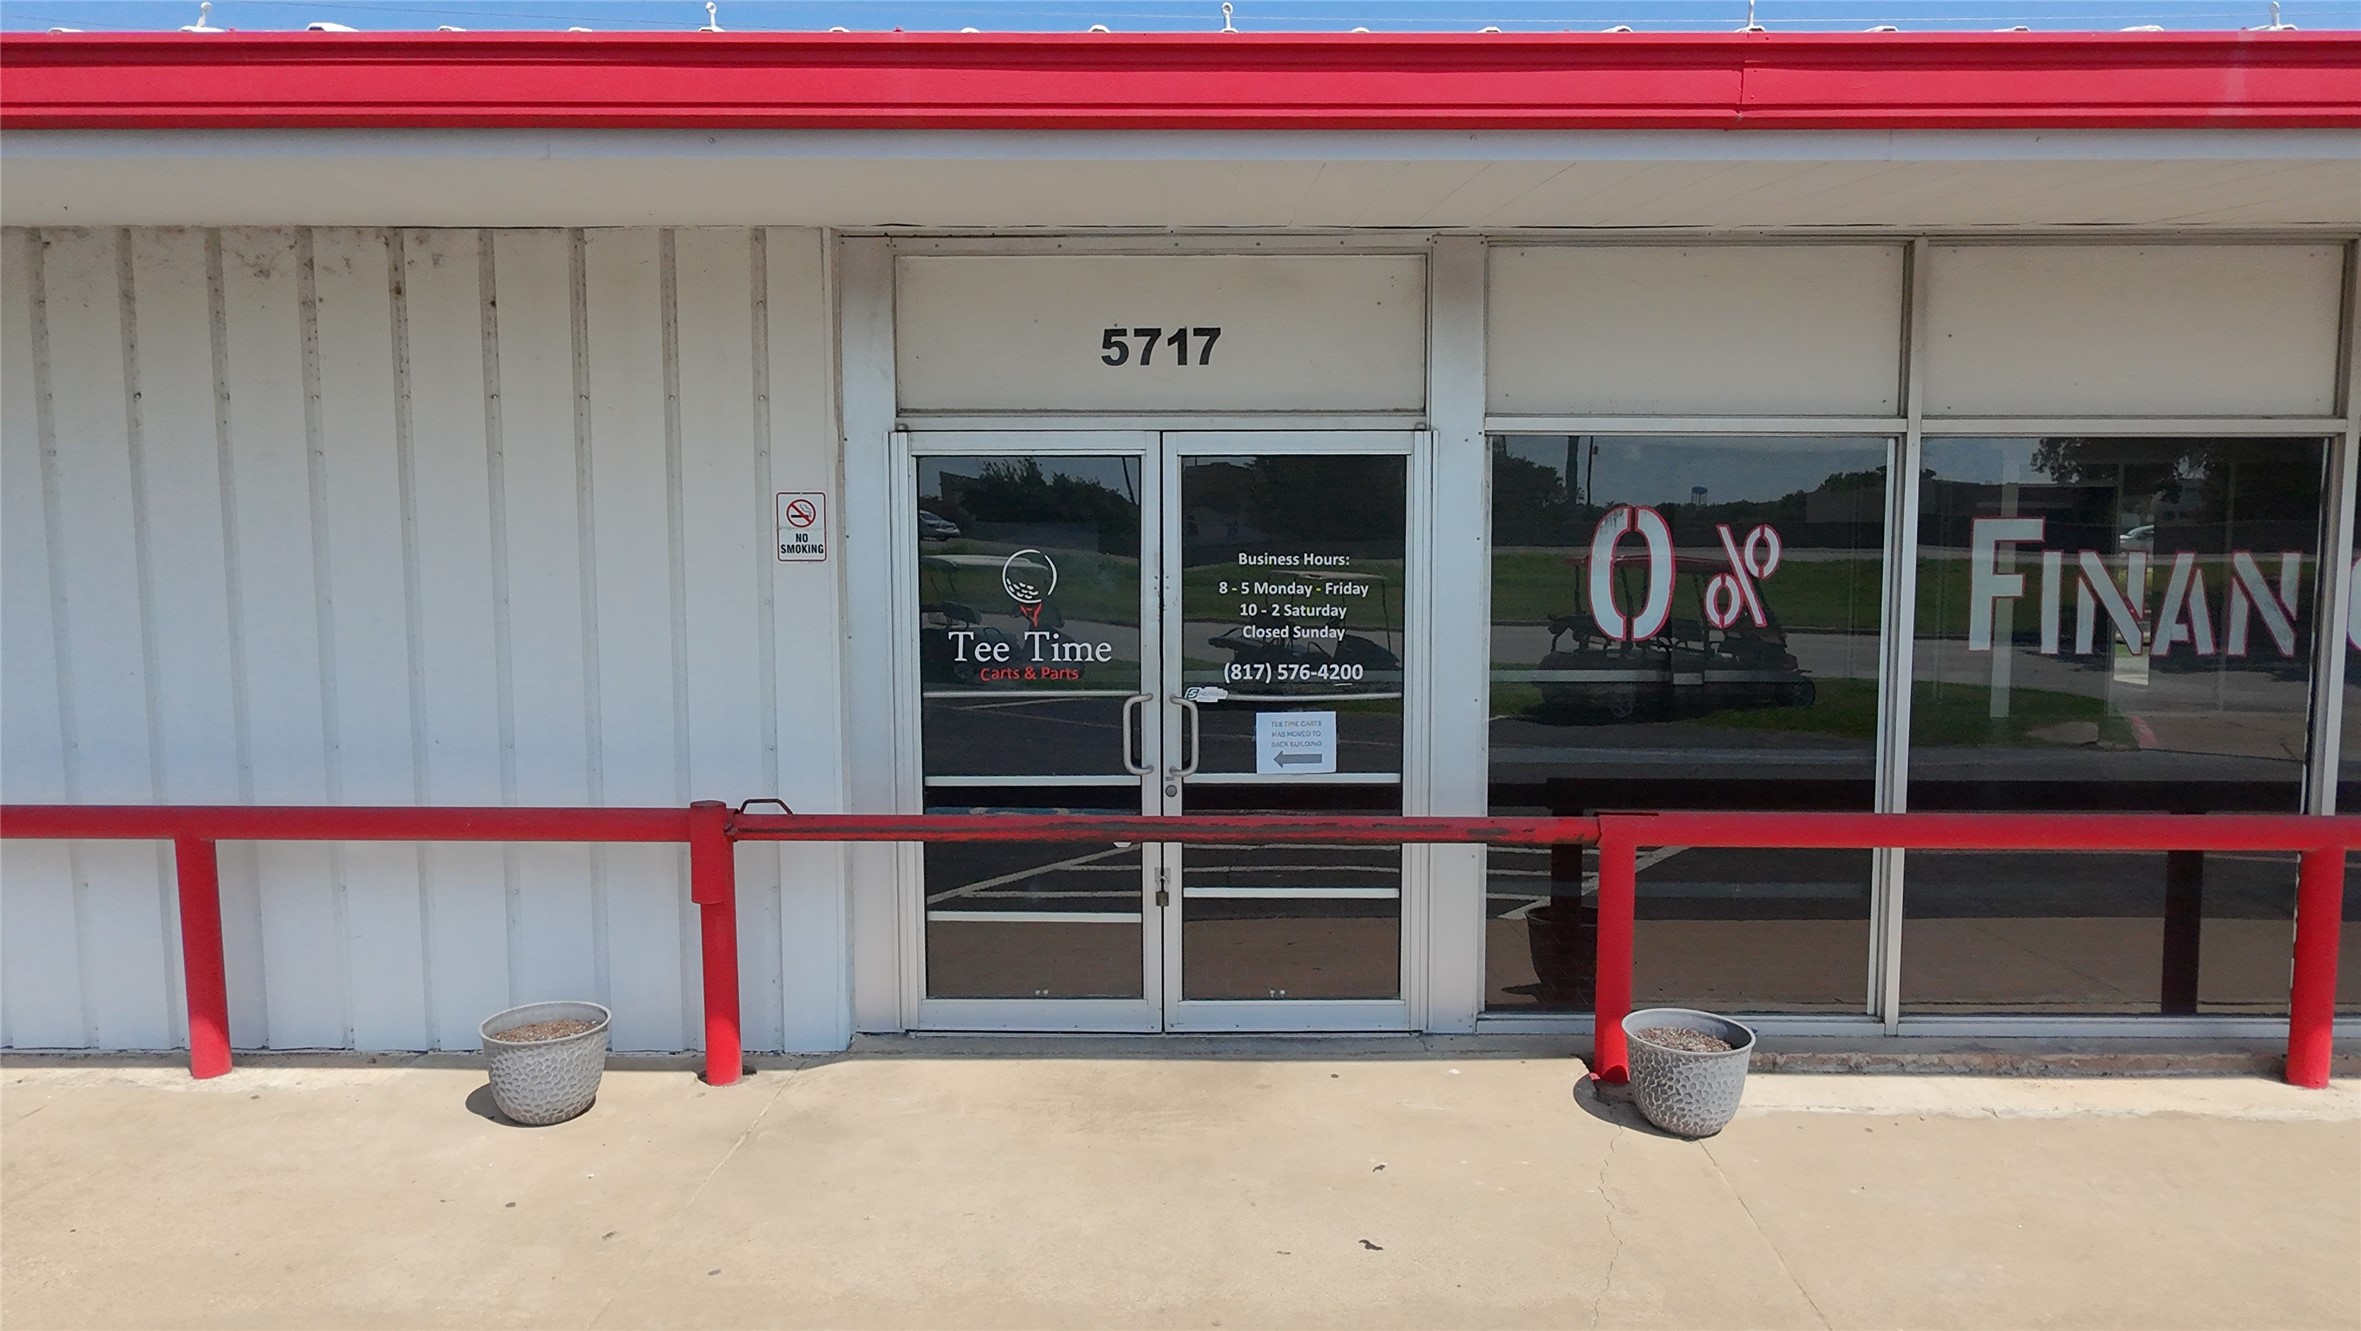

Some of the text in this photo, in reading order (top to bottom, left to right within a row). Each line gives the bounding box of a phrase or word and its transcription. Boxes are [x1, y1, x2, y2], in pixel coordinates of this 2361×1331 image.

[1100, 327, 1222, 366] 5717
[795, 533, 809, 543] NO
[780, 543, 824, 554] SMOKING
[1238, 552, 1350, 566] Business Hours:
[1587, 503, 1676, 642] 0
[1703, 522, 1783, 629] %
[1218, 581, 1228, 594] 8
[1240, 581, 1250, 594] 5
[1254, 581, 1313, 597] Monday
[1325, 581, 1369, 597] Friday
[1240, 603, 1258, 617] 10
[1271, 603, 1280, 617] 2
[1283, 603, 1348, 619] Saturday
[1242, 625, 1346, 641] Closed Sunday
[948, 631, 1112, 662] Tee Time
[979, 665, 1079, 682] Carts & Parts
[1223, 662, 1364, 684] (817) 576-4200
